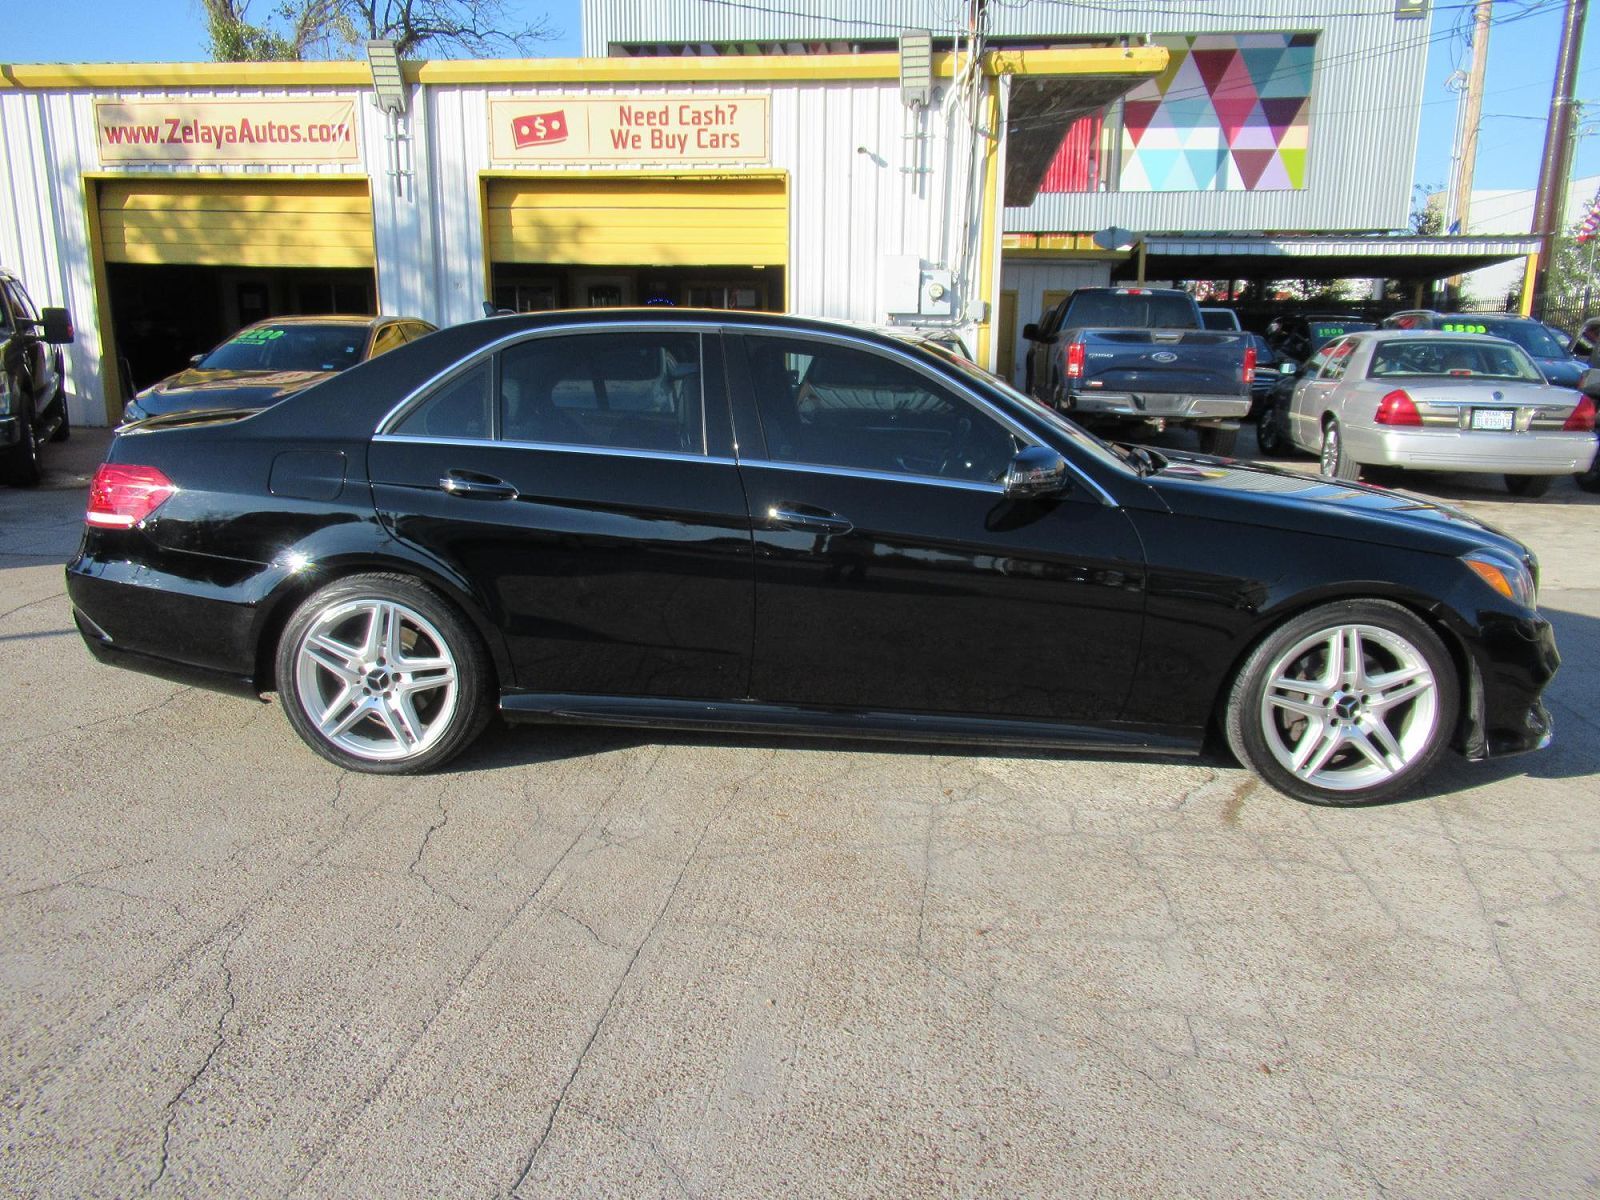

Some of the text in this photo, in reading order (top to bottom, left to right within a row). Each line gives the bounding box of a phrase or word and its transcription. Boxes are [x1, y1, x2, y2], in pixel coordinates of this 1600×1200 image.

[619, 104, 738, 126] Need Cash?
[104, 118, 350, 149] www.ZelayaAutos.com
[610, 128, 740, 154] We Buy Cars
